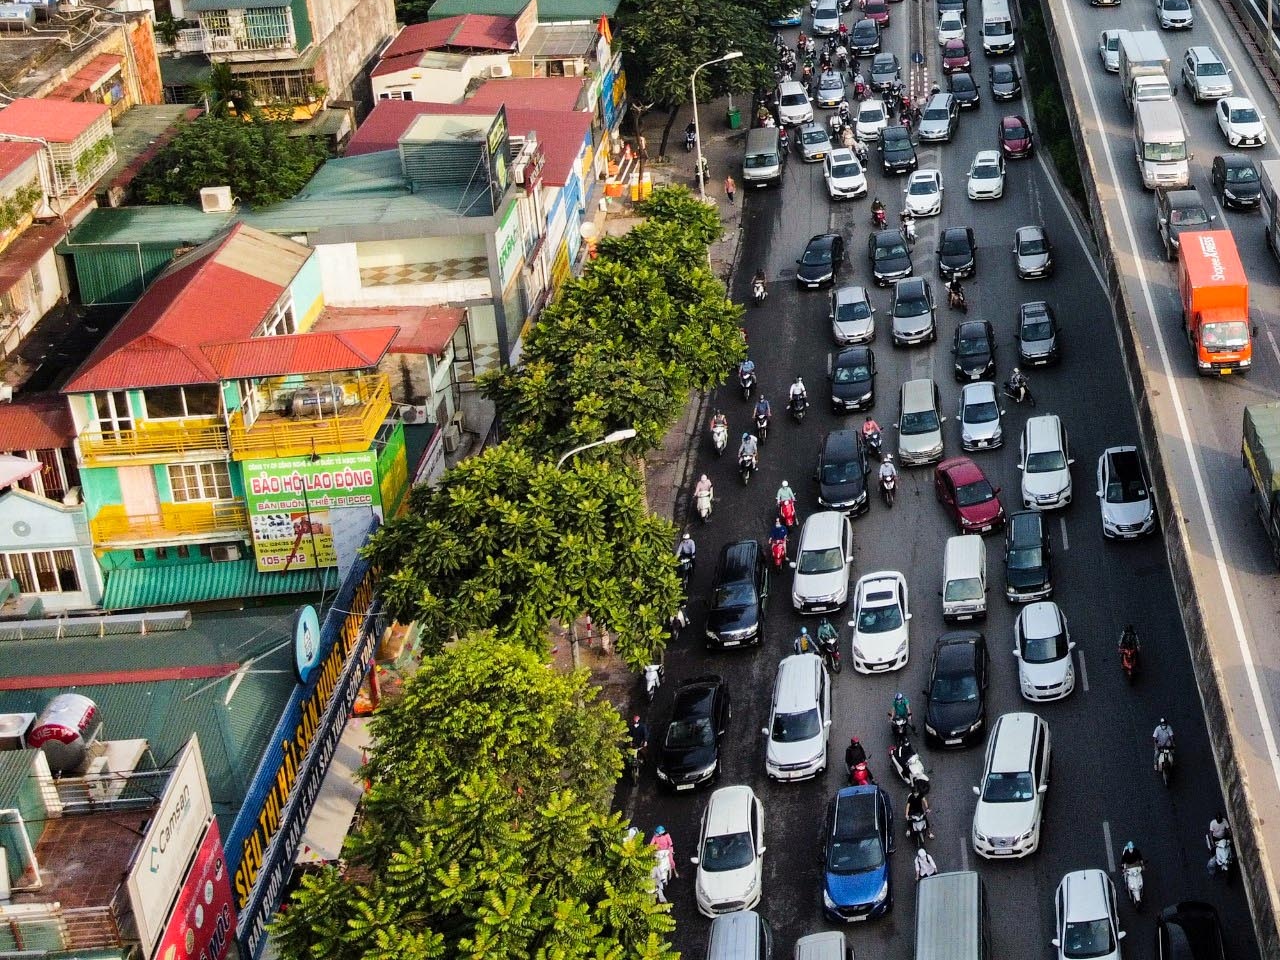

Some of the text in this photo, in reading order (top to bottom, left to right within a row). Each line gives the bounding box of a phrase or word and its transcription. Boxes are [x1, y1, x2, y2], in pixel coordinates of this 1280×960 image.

[252, 467, 373, 495] BẢO HỘ LAO ĐỘNG
[279, 498, 305, 509] BUÔN
[348, 495, 371, 504] PCCC
[158, 783, 191, 855] Camsan
[235, 829, 263, 909] SIÊU
[259, 786, 283, 844] THỊ
[277, 740, 300, 806] HẢI
[295, 695, 319, 761] SẢN
[262, 863, 283, 919] BUÔN
